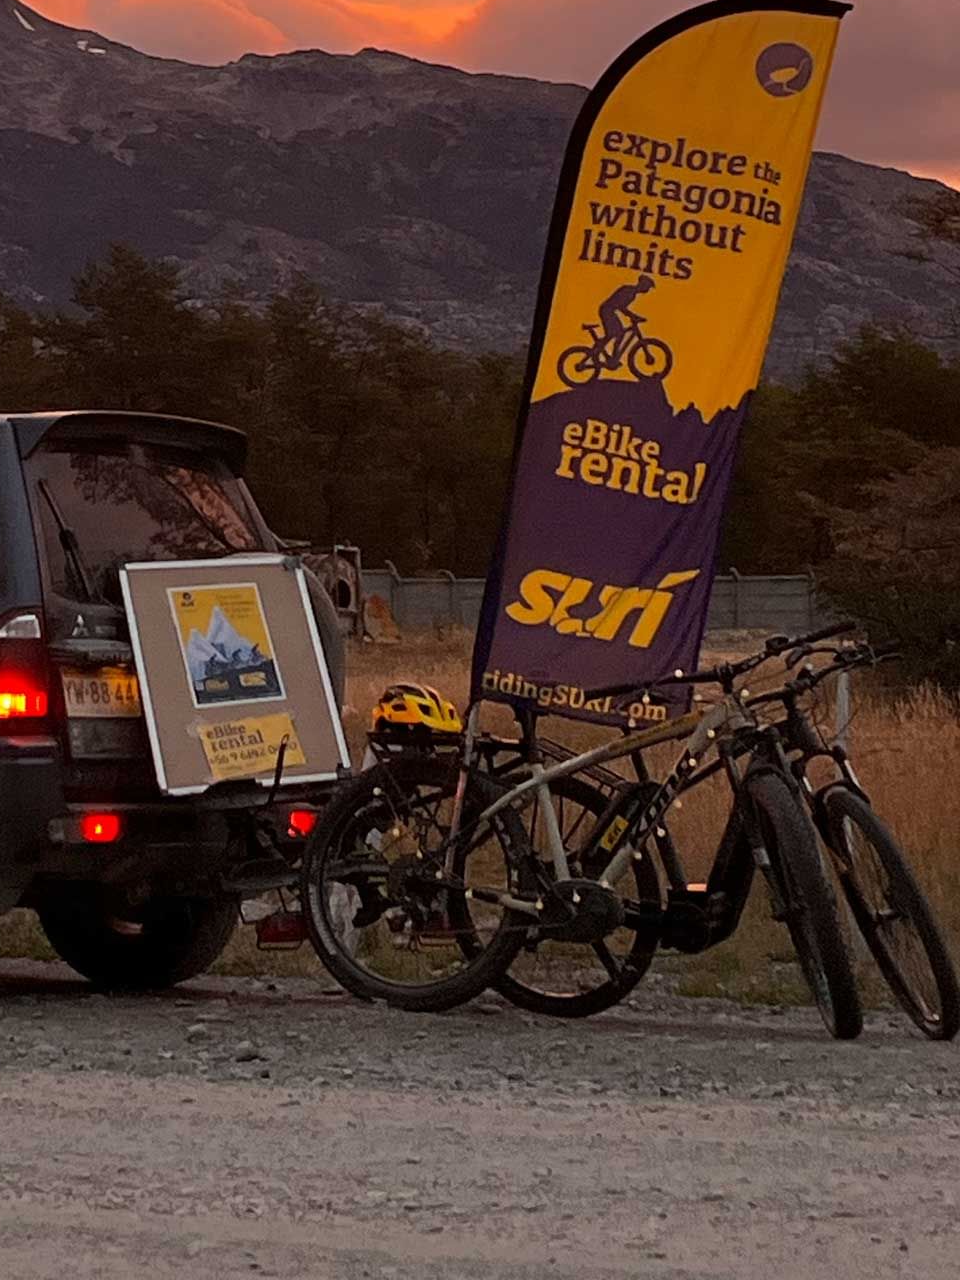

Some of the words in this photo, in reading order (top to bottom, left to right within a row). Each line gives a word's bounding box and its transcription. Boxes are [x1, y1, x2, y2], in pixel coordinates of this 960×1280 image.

[603, 129, 747, 177] explore
[753, 160, 782, 186] the
[595, 158, 782, 226] Patagonia
[589, 200, 746, 253] without
[578, 229, 694, 281] limits
[562, 419, 661, 464] eBike
[555, 444, 707, 505] rental
[206, 723, 246, 739] eBike
[211, 729, 264, 753] rental
